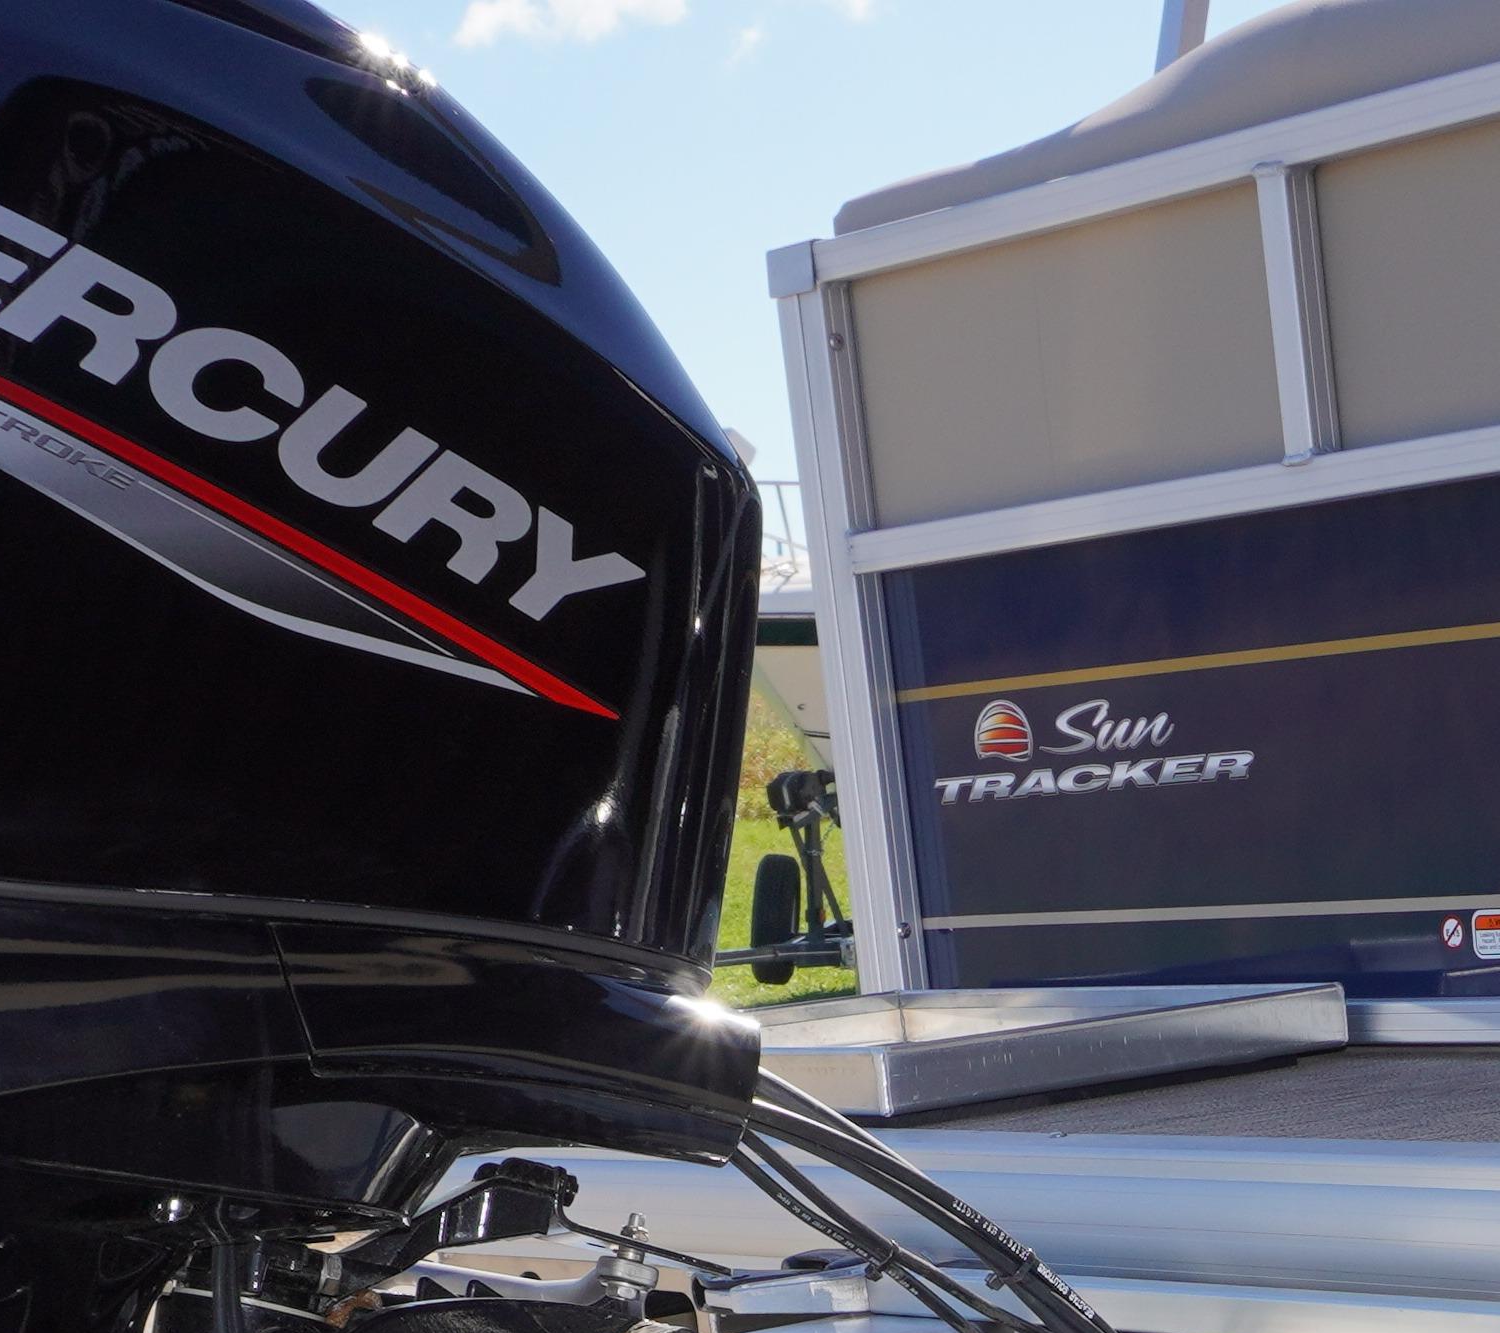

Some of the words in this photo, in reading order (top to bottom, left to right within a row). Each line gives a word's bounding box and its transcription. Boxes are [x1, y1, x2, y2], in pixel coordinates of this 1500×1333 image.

[1039, 698, 1175, 755] Sun
[934, 749, 1255, 806] TRACKER
[1036, 1262, 1069, 1295] SOLUTIONS
[1068, 1290, 1095, 1320] SEASTAR
